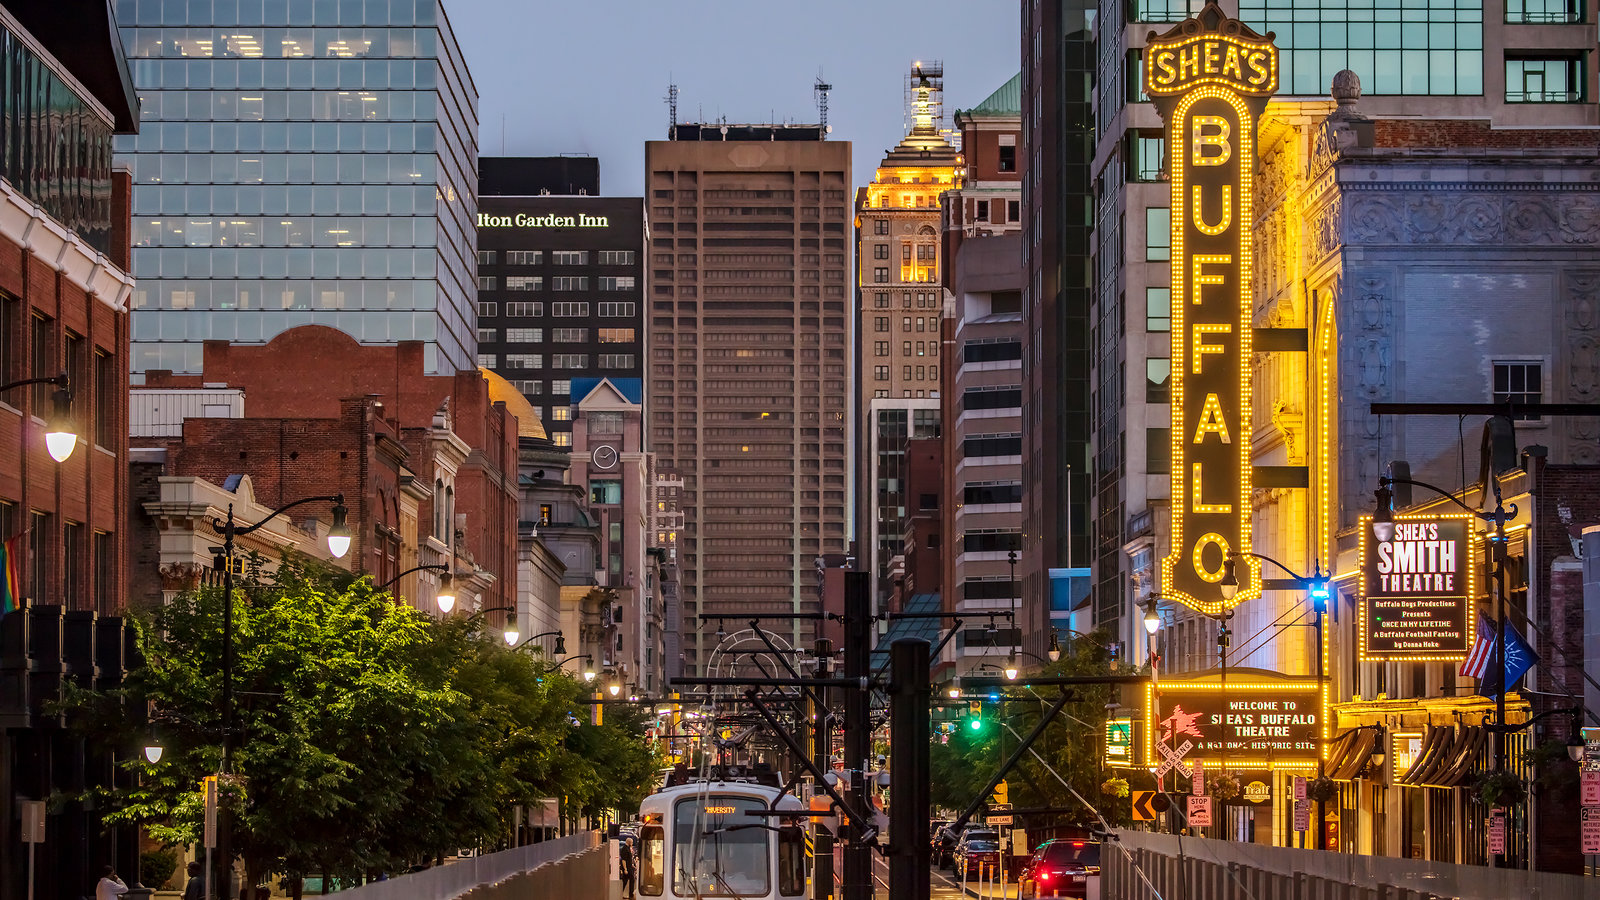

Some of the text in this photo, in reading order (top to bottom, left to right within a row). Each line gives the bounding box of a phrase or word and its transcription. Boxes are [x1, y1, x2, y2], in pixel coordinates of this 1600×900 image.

[1156, 42, 1268, 85] SHEA'S
[477, 213, 609, 228] lton Garden Inn
[1192, 115, 1232, 584] BUFFALO
[1394, 523, 1438, 541] SHEA'S
[1377, 540, 1456, 574] SMITH
[1380, 573, 1454, 592] THEATRE
[1394, 641, 1402, 649] by
[1229, 702, 1296, 710] WELCOME TO
[1260, 714, 1316, 725] BUFFALO
[1234, 726, 1290, 736] THEATRE
[1156, 742, 1170, 757] RAIL
[1158, 743, 1190, 775] CROSSING
[1176, 761, 1191, 777] ROAD
[709, 884, 714, 892] 6
